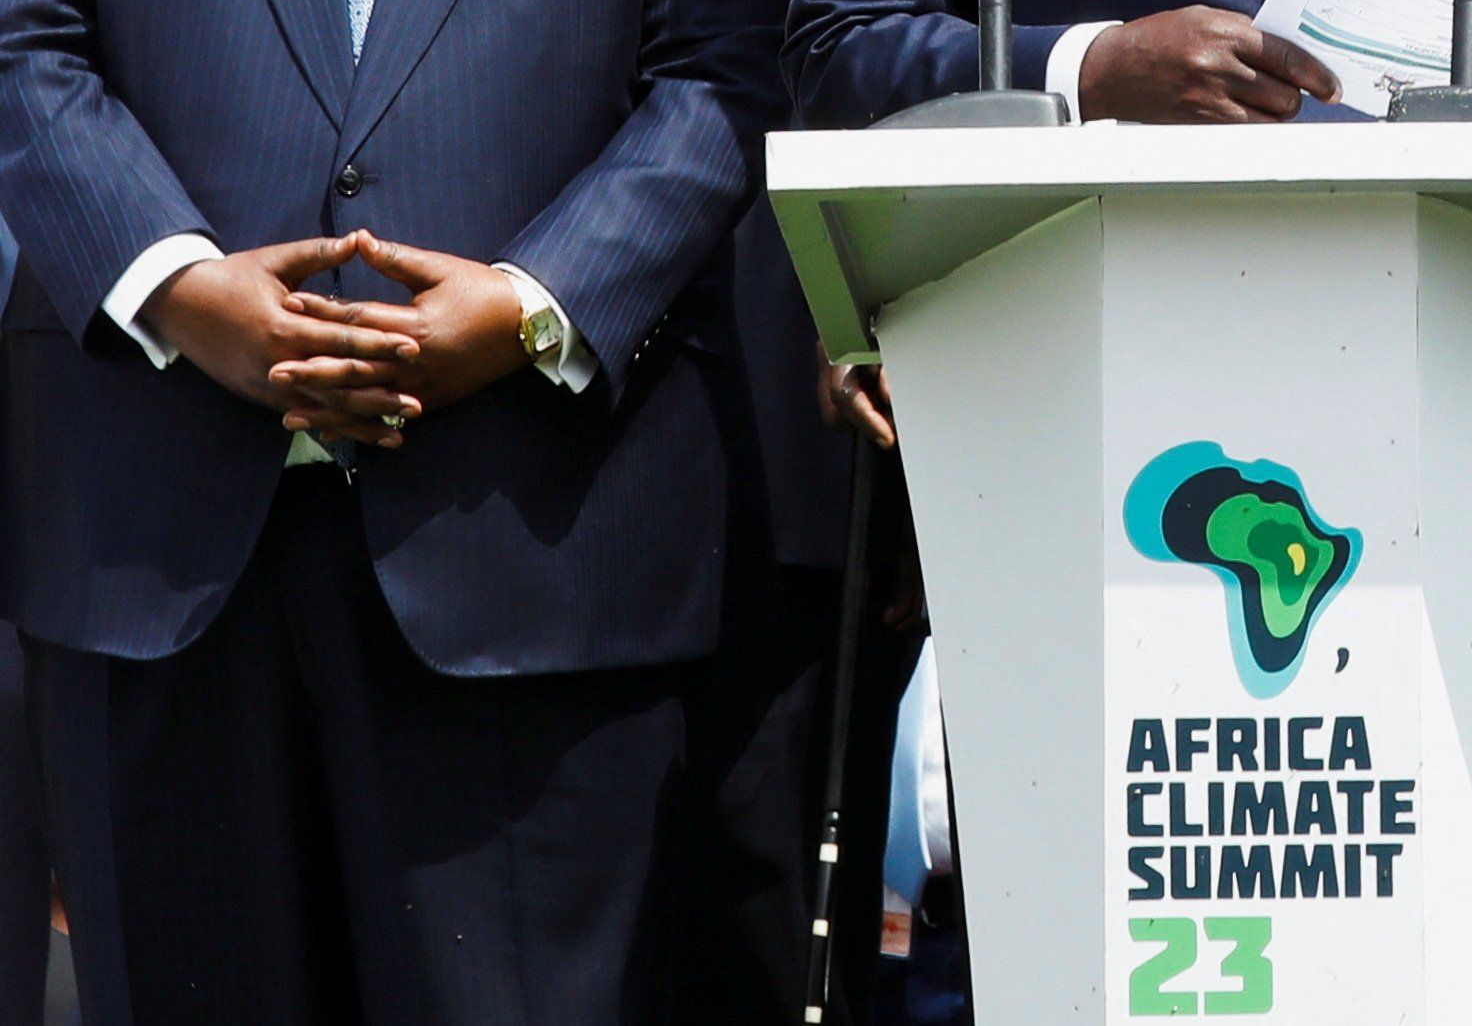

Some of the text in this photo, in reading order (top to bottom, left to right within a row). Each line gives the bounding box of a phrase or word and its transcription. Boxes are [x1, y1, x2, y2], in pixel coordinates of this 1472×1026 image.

[1126, 716, 1372, 772] AFRICA
[1127, 779, 1417, 837] CLIMATE
[1127, 843, 1404, 900] SUMMIT
[1128, 916, 1273, 1016] 23
